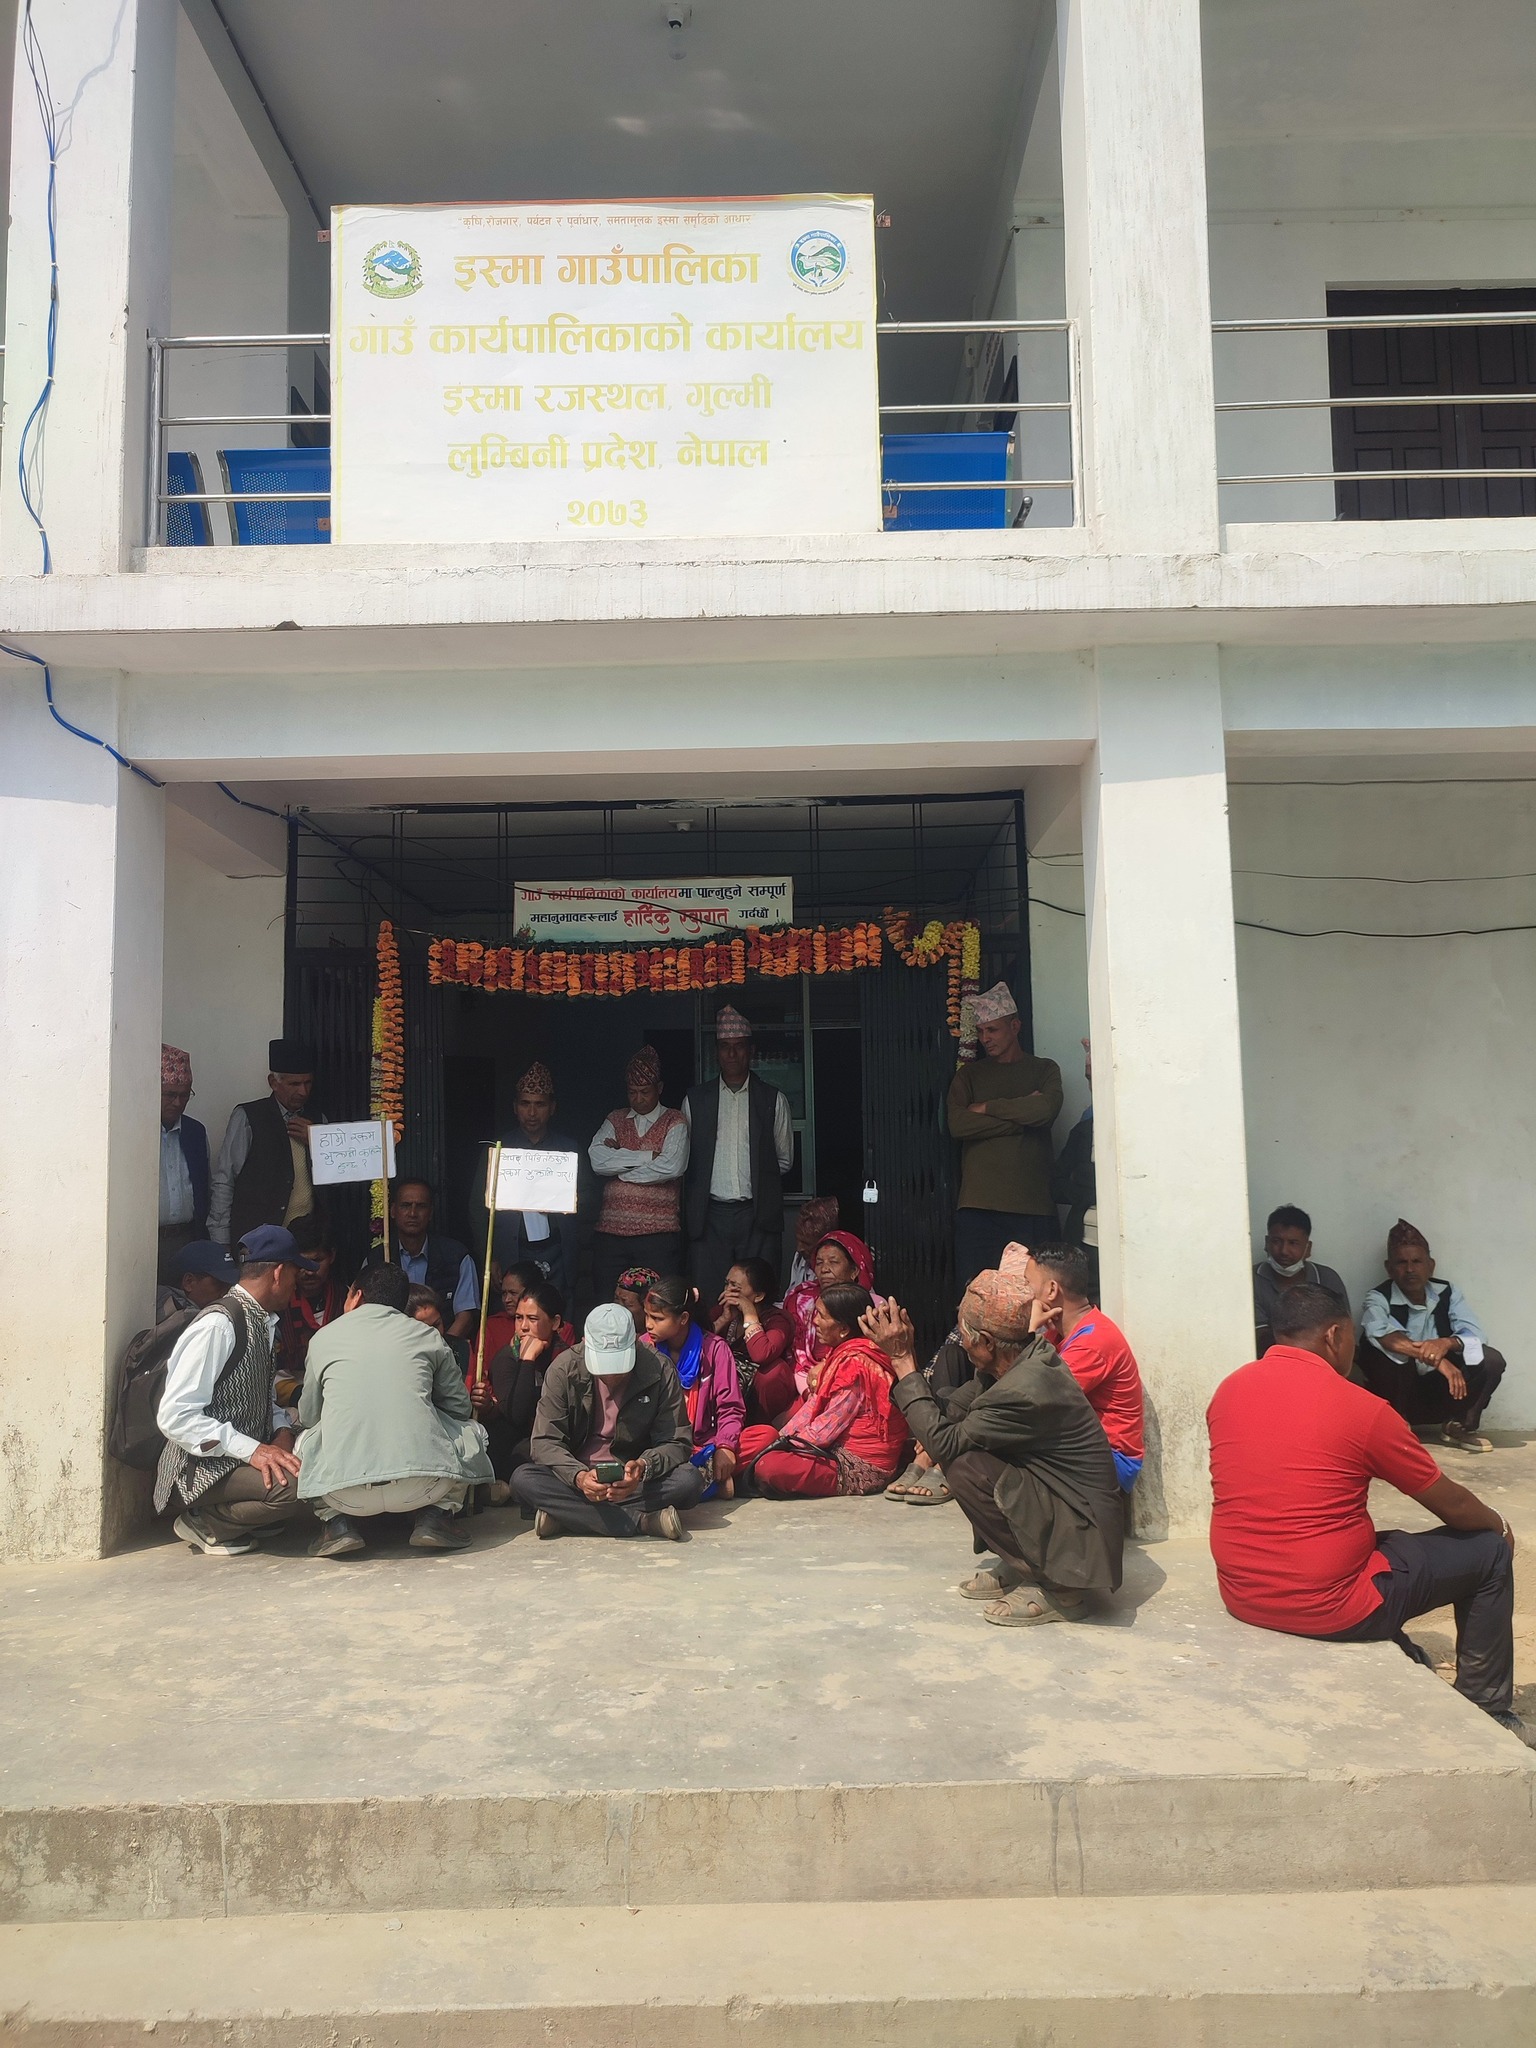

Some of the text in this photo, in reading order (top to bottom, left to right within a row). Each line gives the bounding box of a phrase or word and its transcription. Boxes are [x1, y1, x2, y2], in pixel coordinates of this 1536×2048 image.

[527, 214, 552, 226] पर्यटन
[556, 216, 563, 227] र
[607, 215, 653, 227] समतामूलक
[657, 215, 679, 226] इस्मा
[453, 243, 761, 291] इस्मा गाउँपालिका
[349, 312, 866, 355] गाउँ कार्यपालिकाको कार्यालय
[443, 385, 523, 416] इस्मा
[686, 373, 774, 417] गुल्मी
[447, 432, 570, 479] लुम्बिनी
[676, 431, 770, 468] नेपाल
[567, 499, 649, 529] २०७३
[631, 885, 693, 900] कार्यालयमा
[696, 884, 742, 900] पाल्नुहुने
[747, 882, 787, 900] सम्पूर्ण
[622, 903, 672, 935] हार्दिक
[679, 907, 730, 934] स्वागत
[320, 1128, 375, 1148] हाम्रो रकम
